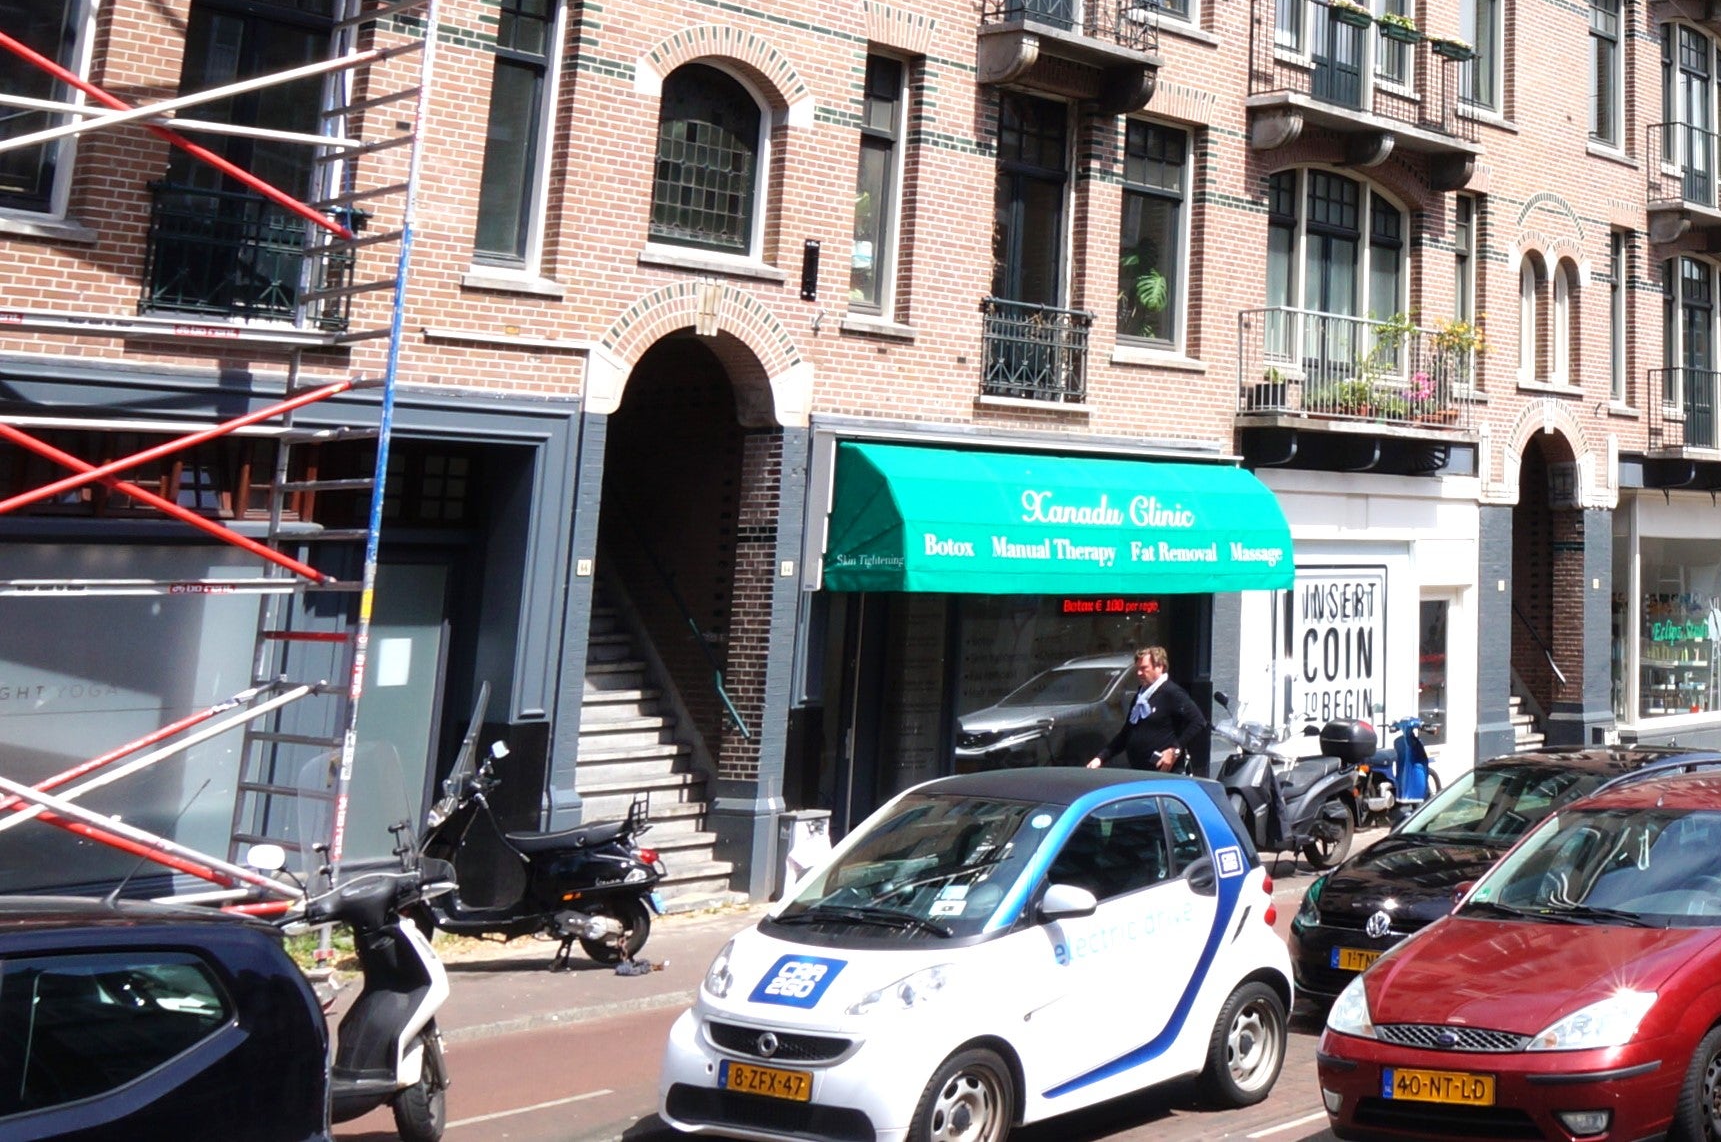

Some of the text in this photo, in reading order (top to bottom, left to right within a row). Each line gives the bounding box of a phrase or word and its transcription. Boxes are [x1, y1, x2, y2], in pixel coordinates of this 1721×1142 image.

[1021, 489, 1195, 528] Xanadu Clinic
[836, 553, 904, 569] Skin Tightening
[924, 533, 1284, 568] Botox Manual Therapy Fat Removal Massage
[1063, 599, 1094, 612] Botox
[1095, 599, 1102, 612] €
[1304, 582, 1377, 620] INSERT
[1303, 626, 1373, 683] COIN
[56, 684, 118, 699] YOGA
[1304, 688, 1373, 722] TO BEGIN
[1054, 902, 1193, 965] electric drive
[778, 961, 828, 982] CAR
[764, 977, 816, 998] 2GO
[734, 1067, 803, 1095] 8-ZFX-47
[1397, 1075, 1487, 1099] 40-NT-LD
